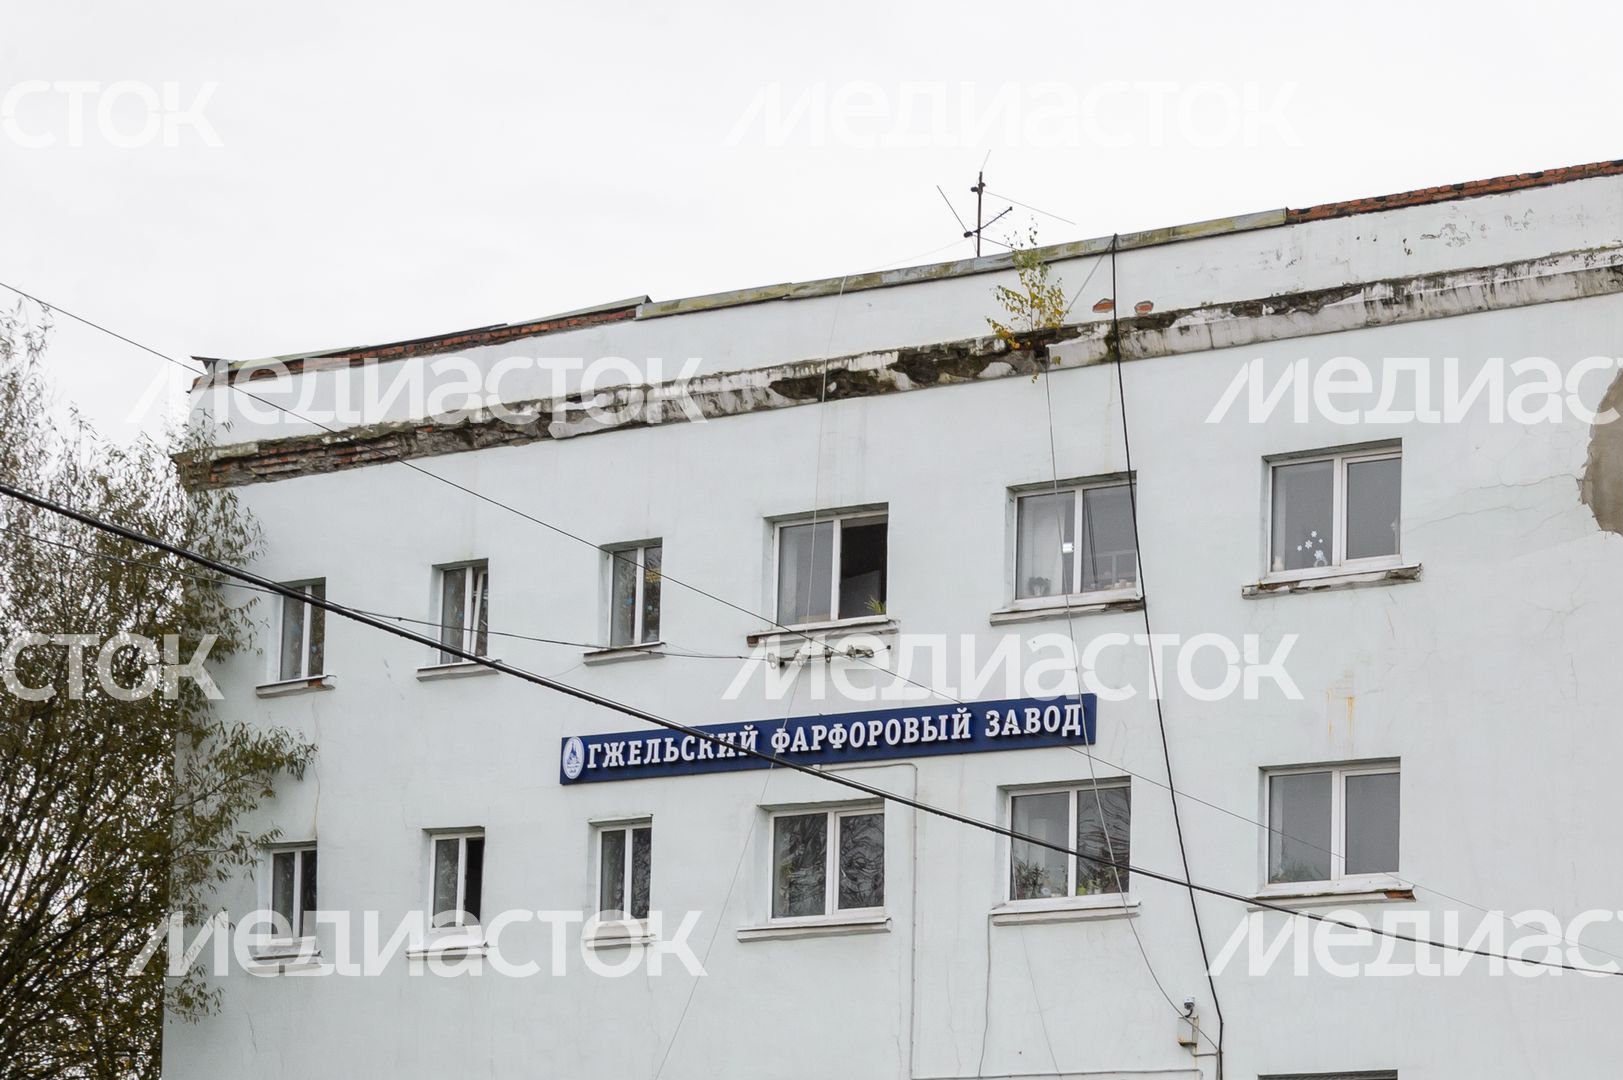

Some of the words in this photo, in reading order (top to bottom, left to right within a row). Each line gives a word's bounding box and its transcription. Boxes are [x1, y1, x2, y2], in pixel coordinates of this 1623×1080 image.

[587, 725, 759, 769] ГЖЕЛЬСКИЙ
[770, 706, 972, 753] ФАРФОРОВЫЙ
[985, 704, 1083, 737] ЗАВОД
